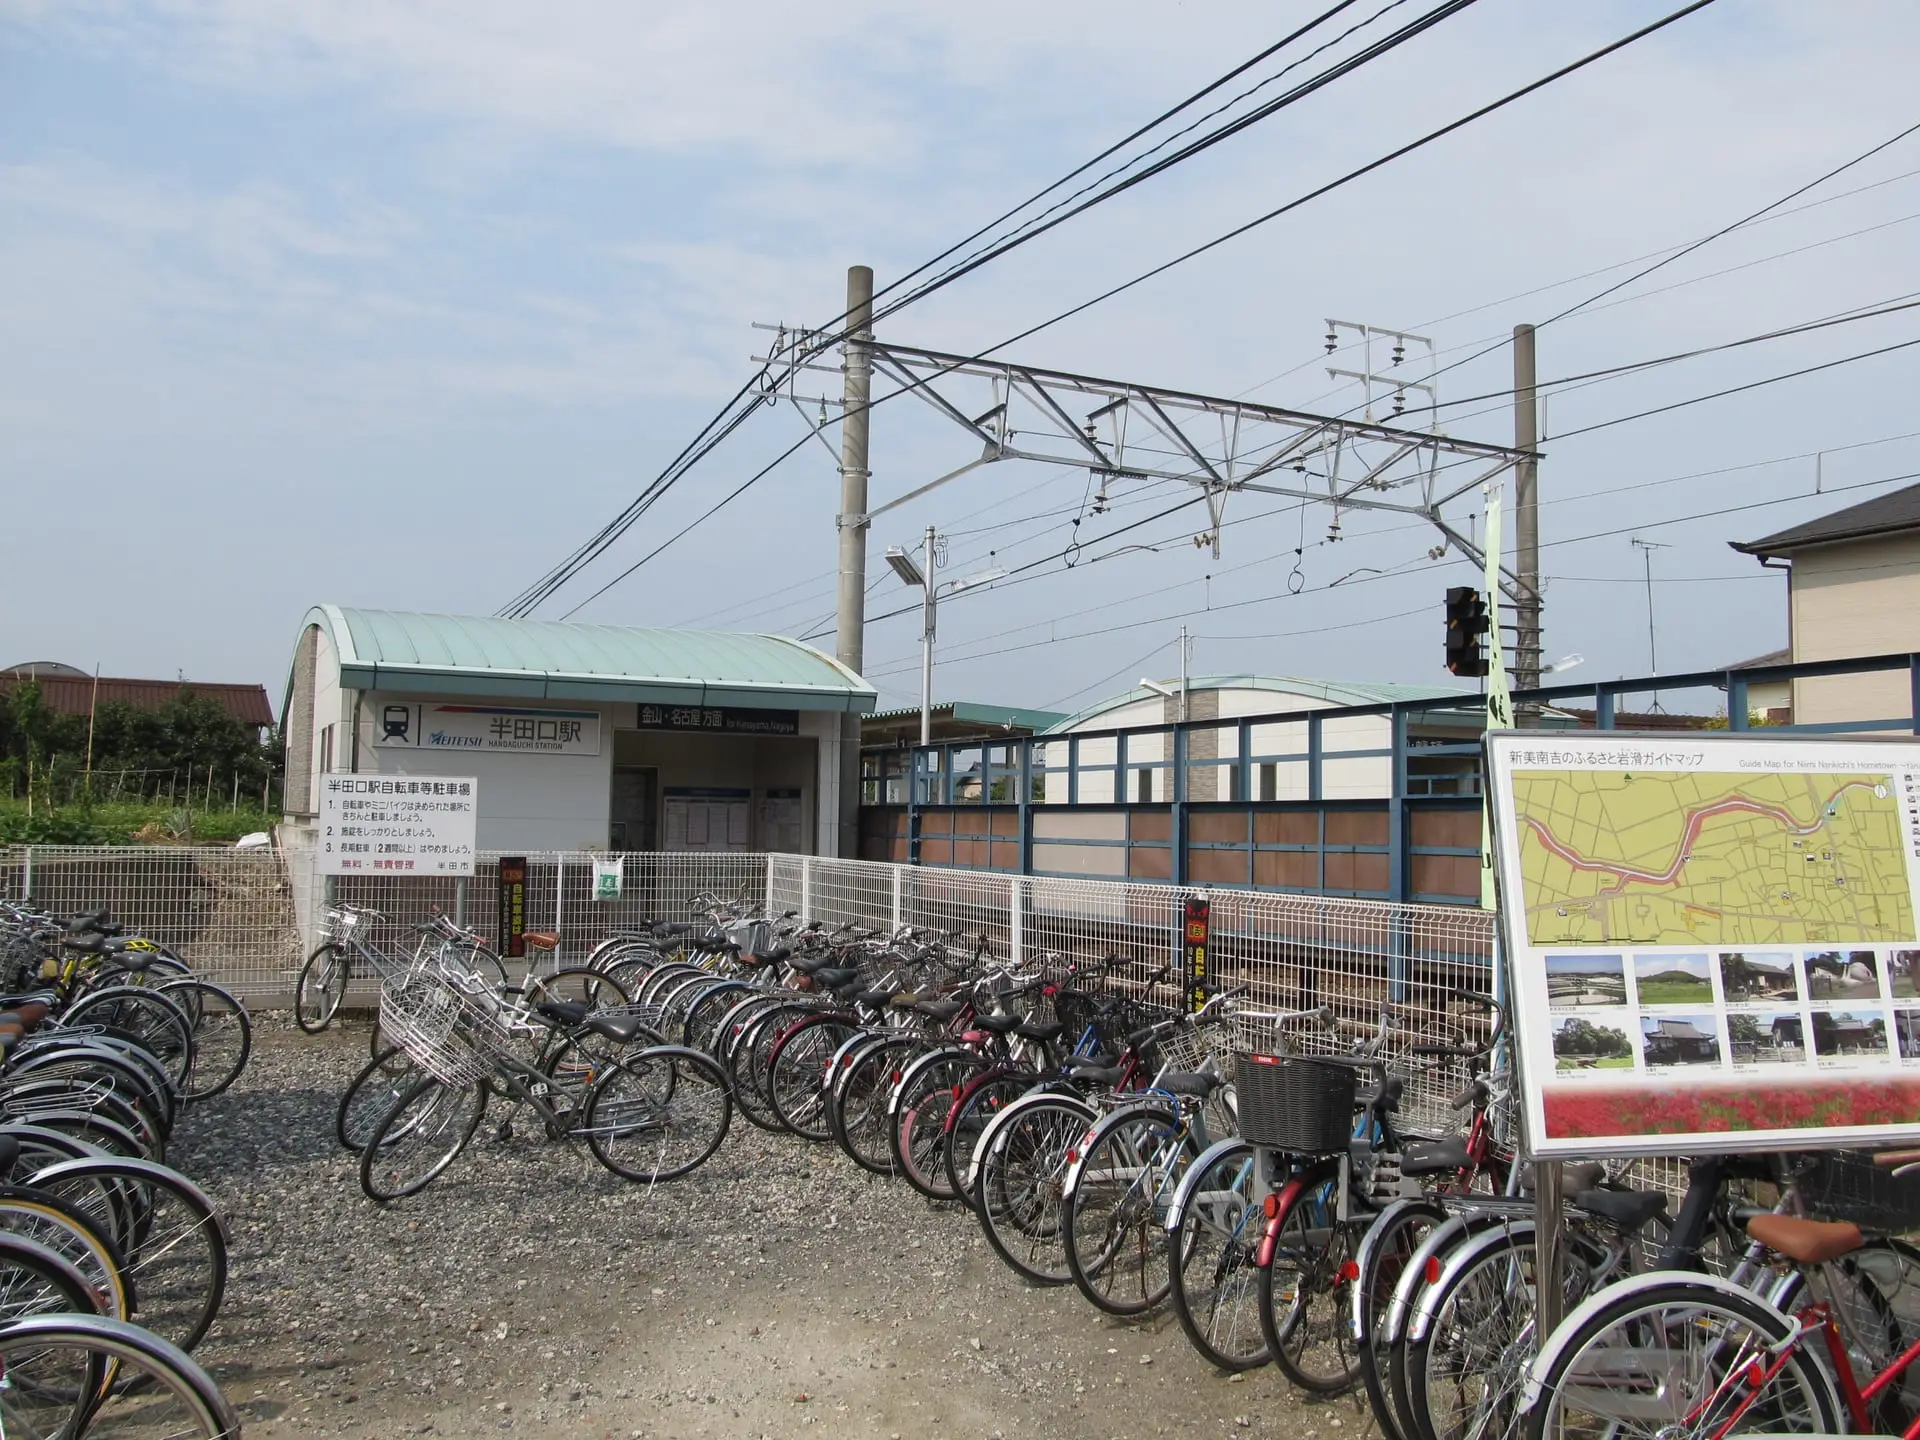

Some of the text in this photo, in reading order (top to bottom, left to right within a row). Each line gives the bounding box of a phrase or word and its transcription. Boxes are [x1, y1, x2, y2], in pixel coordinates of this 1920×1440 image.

[489, 717, 582, 743] 半田口駅
[429, 730, 482, 747] MEITETSU
[488, 741, 563, 750] HANDAGUCHI STATION
[1509, 750, 1704, 766] 新美南吉のふるさと岩滑ガイドマップ
[1739, 760, 1762, 768] Guide
[1764, 760, 1781, 770] Map
[1783, 760, 1795, 768] for
[1857, 762, 1897, 770] Hometown
[328, 779, 471, 796] 半田口駅自転車等駐車場
[328, 800, 471, 812] 1. 自転車やミニバイクは決められた場所に
[342, 812, 423, 823] きちんと駐車しましょう。
[326, 827, 335, 837] 2.
[325, 843, 335, 853] 3.
[438, 862, 469, 871] 半田市
